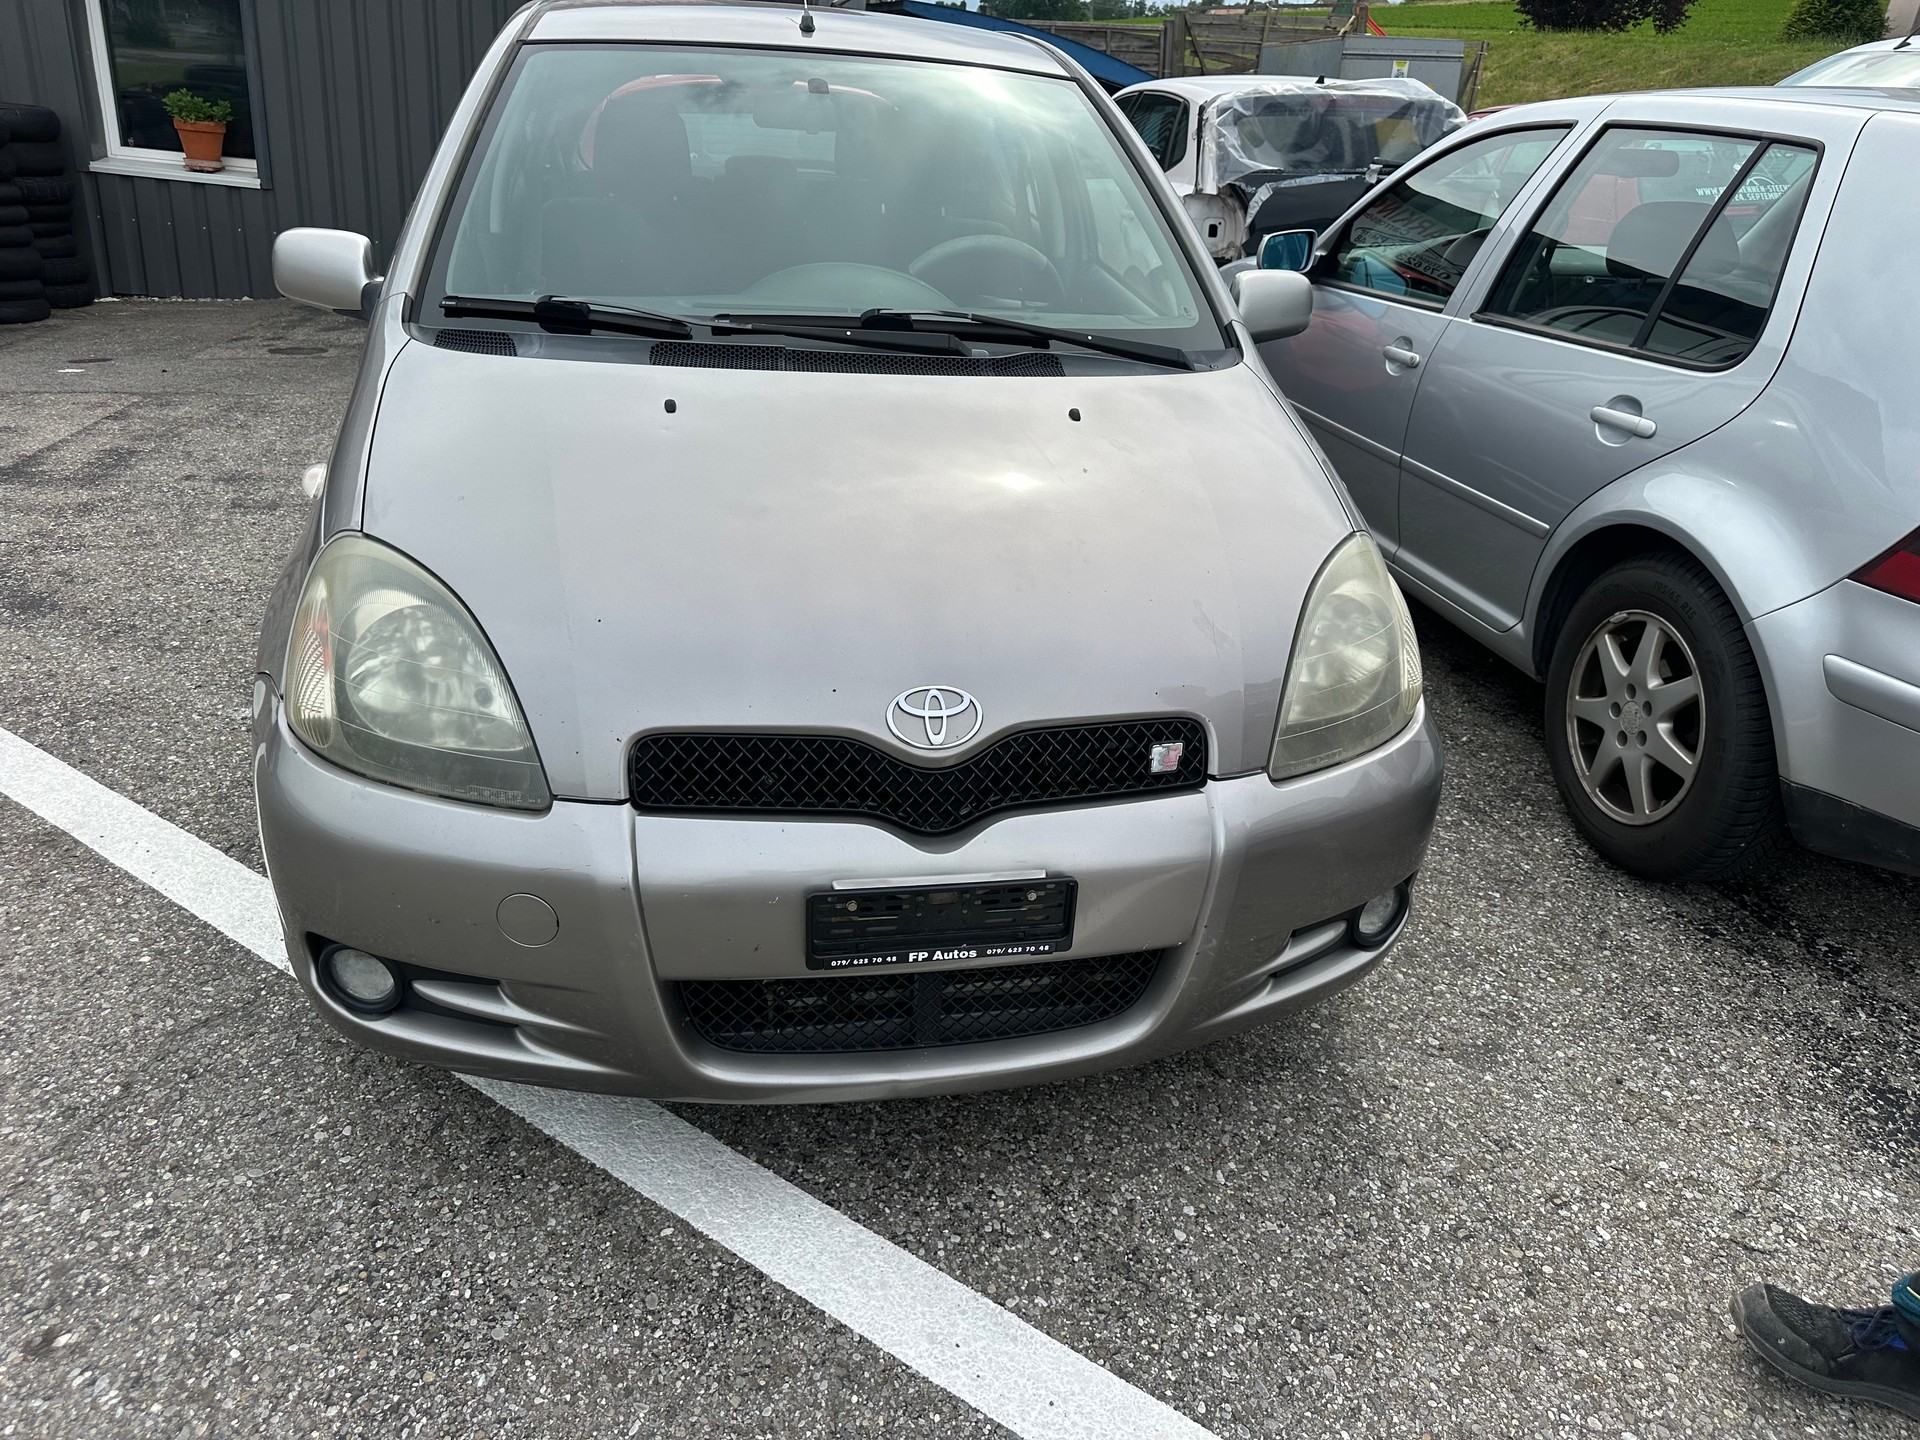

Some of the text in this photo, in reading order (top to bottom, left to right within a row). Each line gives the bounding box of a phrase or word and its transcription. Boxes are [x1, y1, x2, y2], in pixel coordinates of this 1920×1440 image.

[1652, 580, 1697, 620] 195/65 R15
[830, 959, 851, 967] 079/
[908, 951, 929, 963] FP
[932, 949, 978, 961] Autos
[986, 947, 1006, 955] 079/
